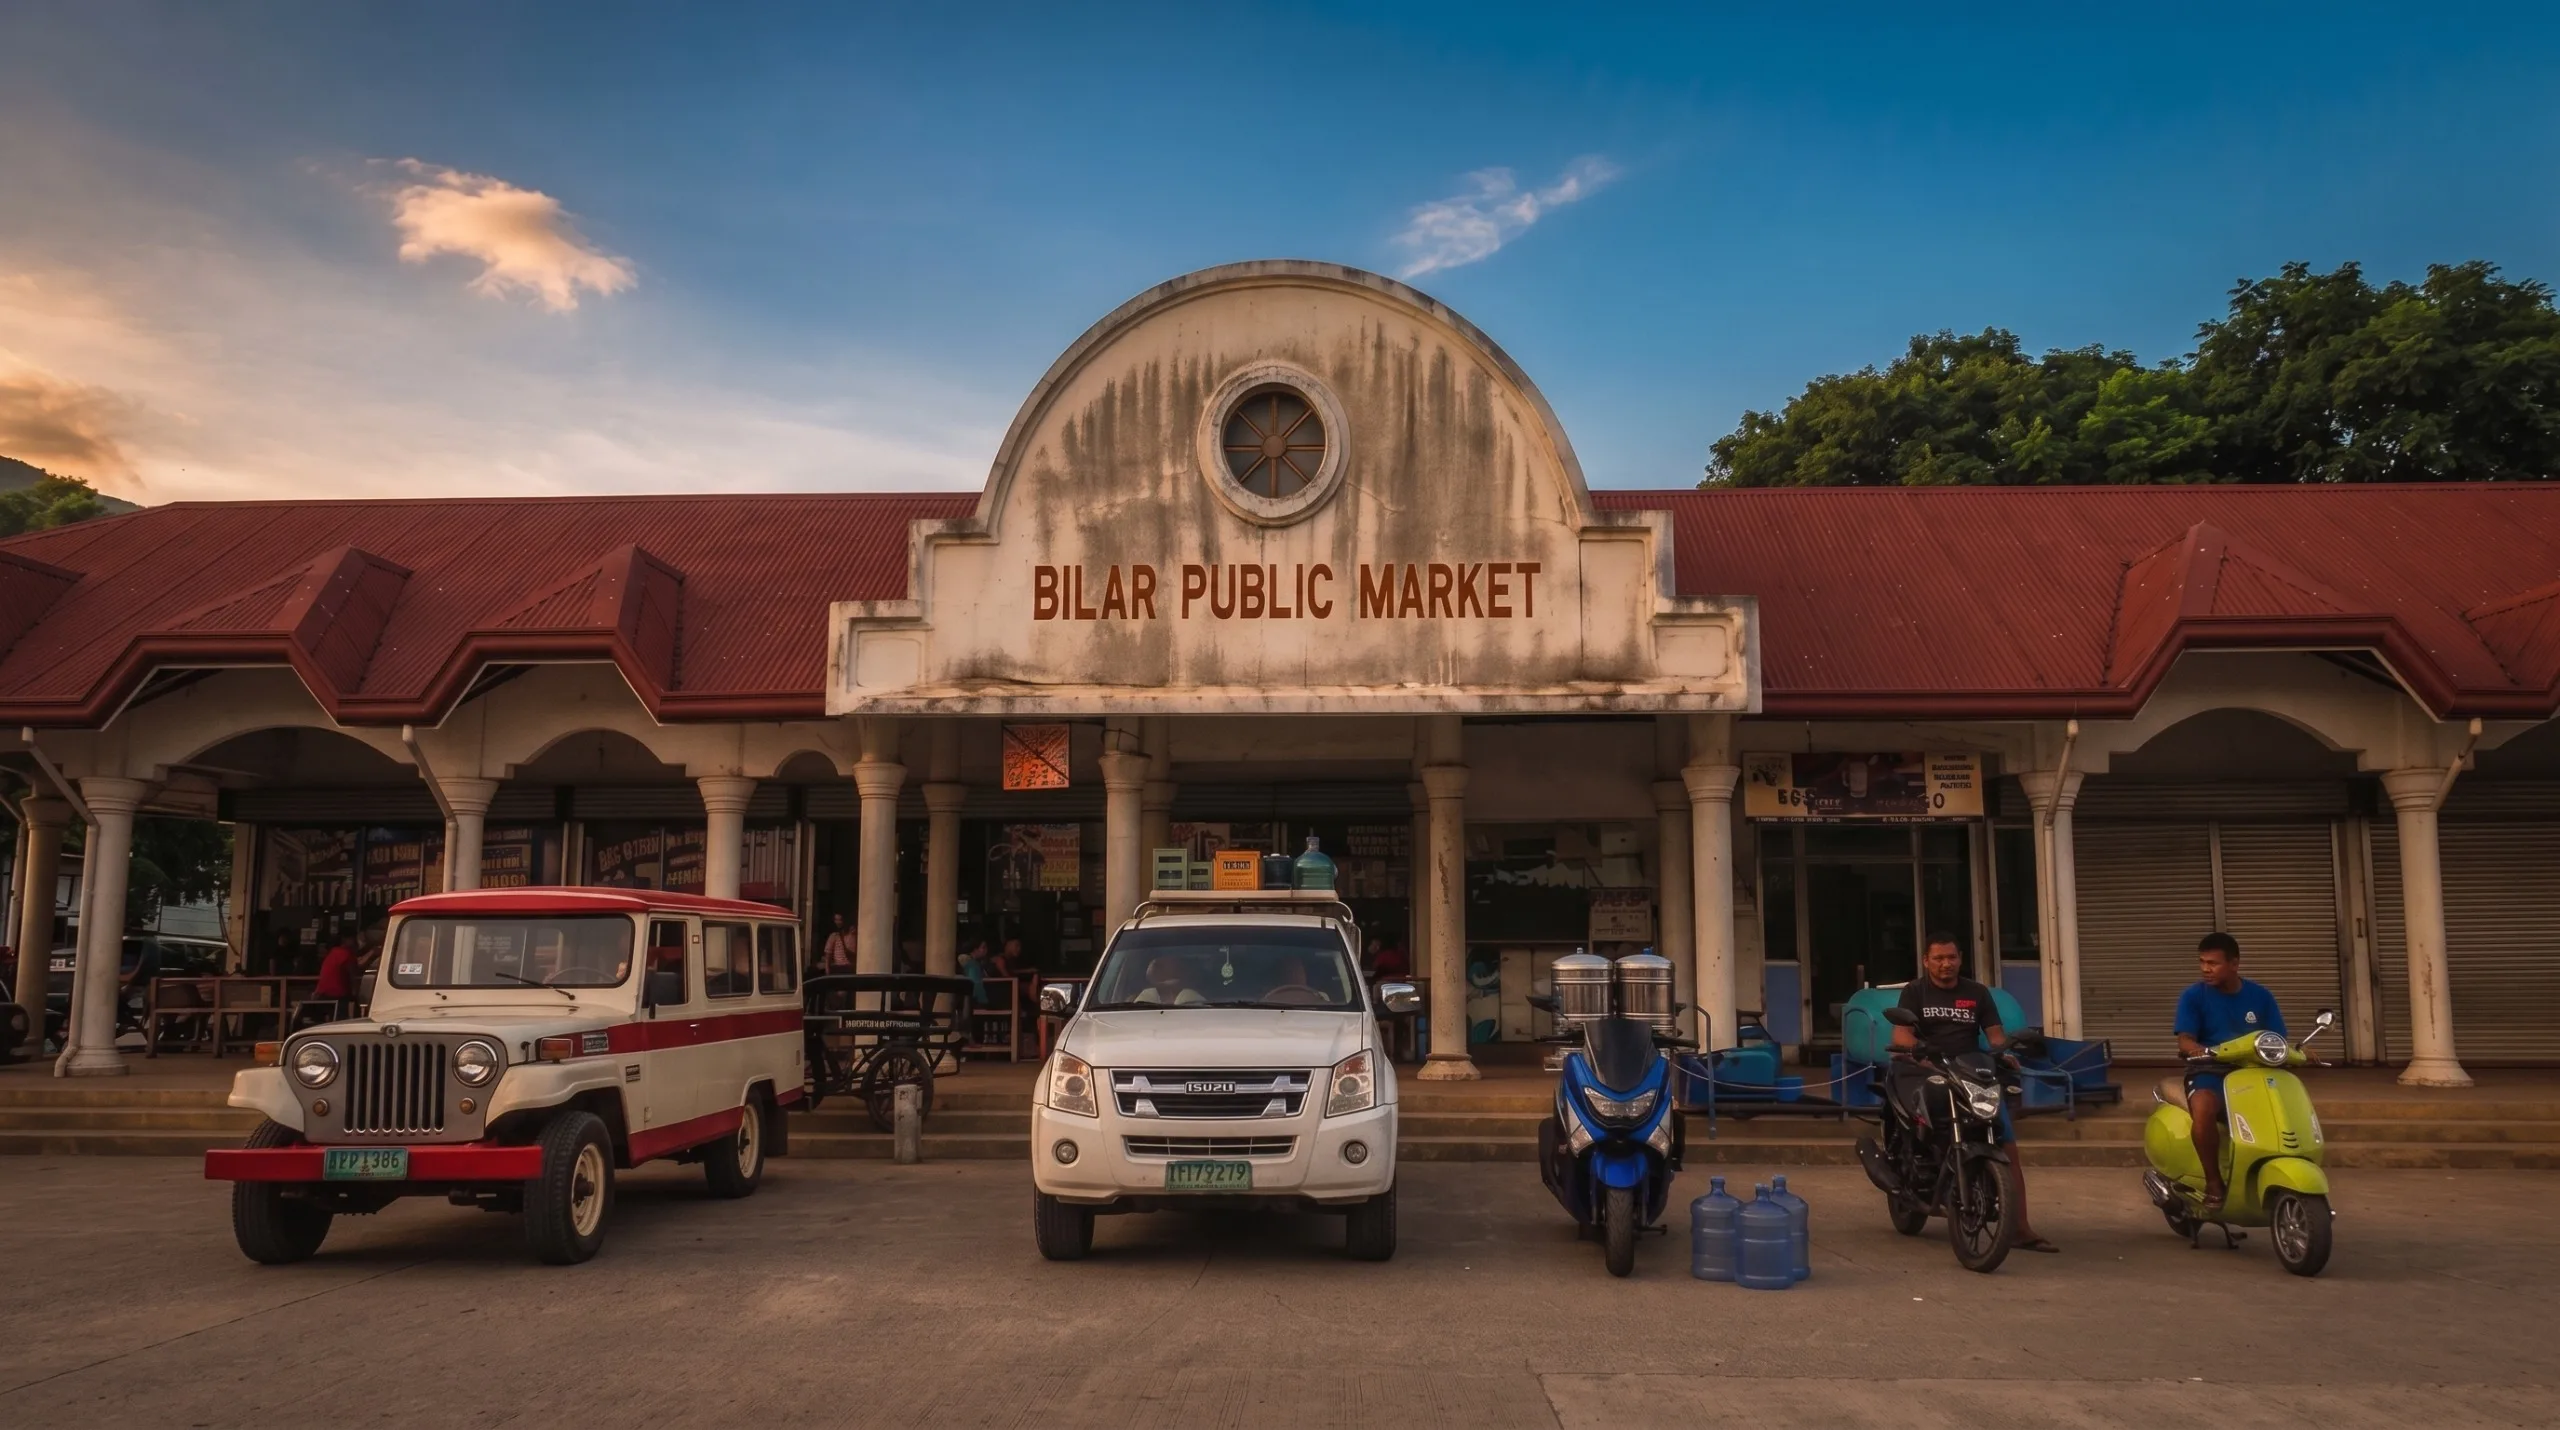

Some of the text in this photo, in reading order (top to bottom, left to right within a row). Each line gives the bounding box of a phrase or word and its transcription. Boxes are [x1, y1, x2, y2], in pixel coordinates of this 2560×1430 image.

[1034, 562, 1541, 620] BILAR PUBLIC MARKET
[1188, 1083, 1233, 1092] ISUZU
